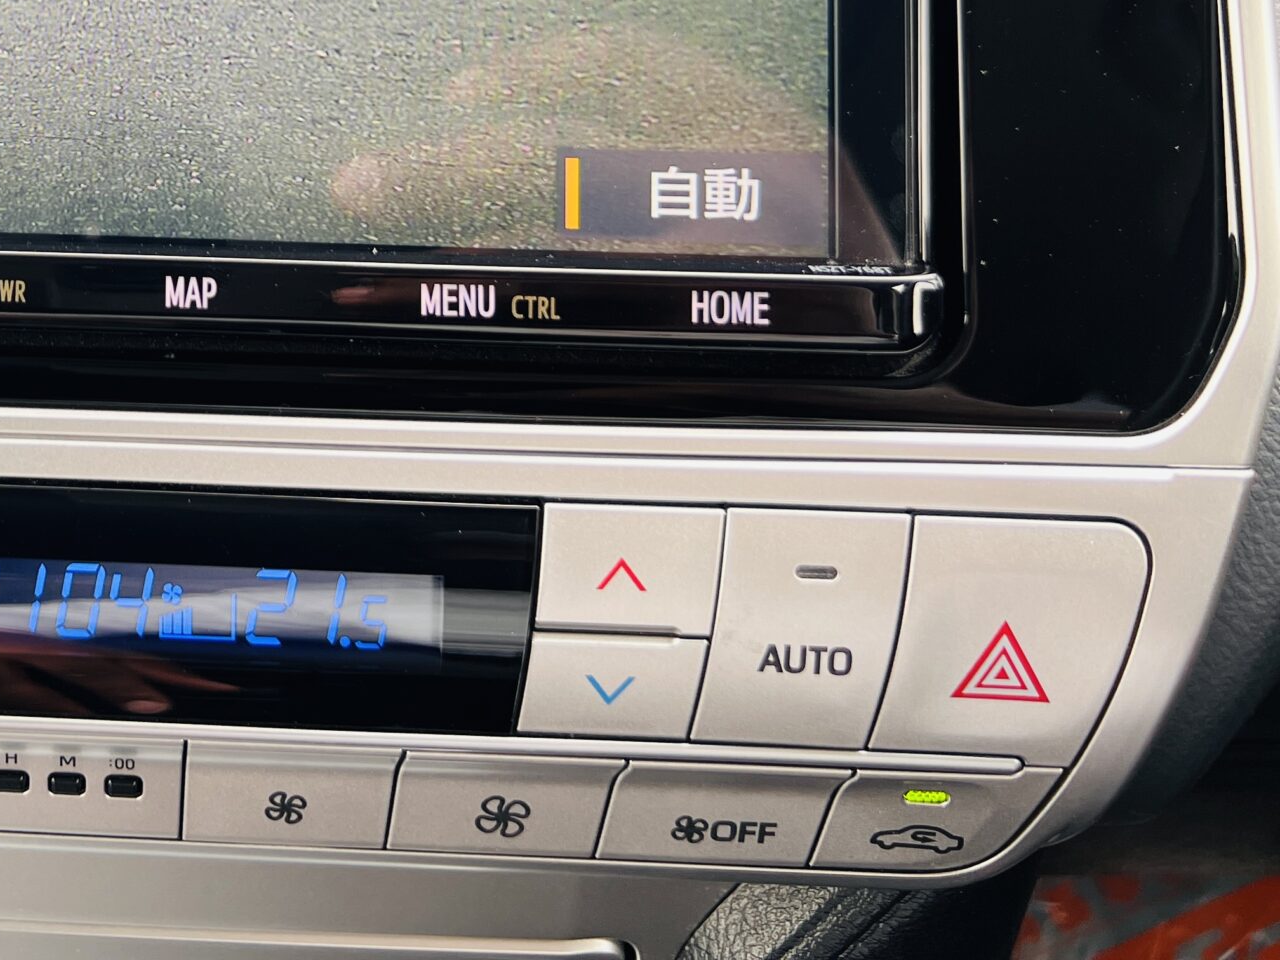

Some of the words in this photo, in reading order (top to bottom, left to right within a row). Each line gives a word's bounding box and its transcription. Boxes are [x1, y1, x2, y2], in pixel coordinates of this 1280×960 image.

[648, 166, 763, 224] 自動
[164, 276, 218, 310] MAP
[419, 283, 497, 319] MENU
[510, 295, 561, 322] CTRL
[690, 290, 771, 326] HOME
[757, 644, 853, 677] AUTO
[4, 752, 18, 764] H
[59, 755, 76, 767] M
[709, 820, 778, 844] OFF
